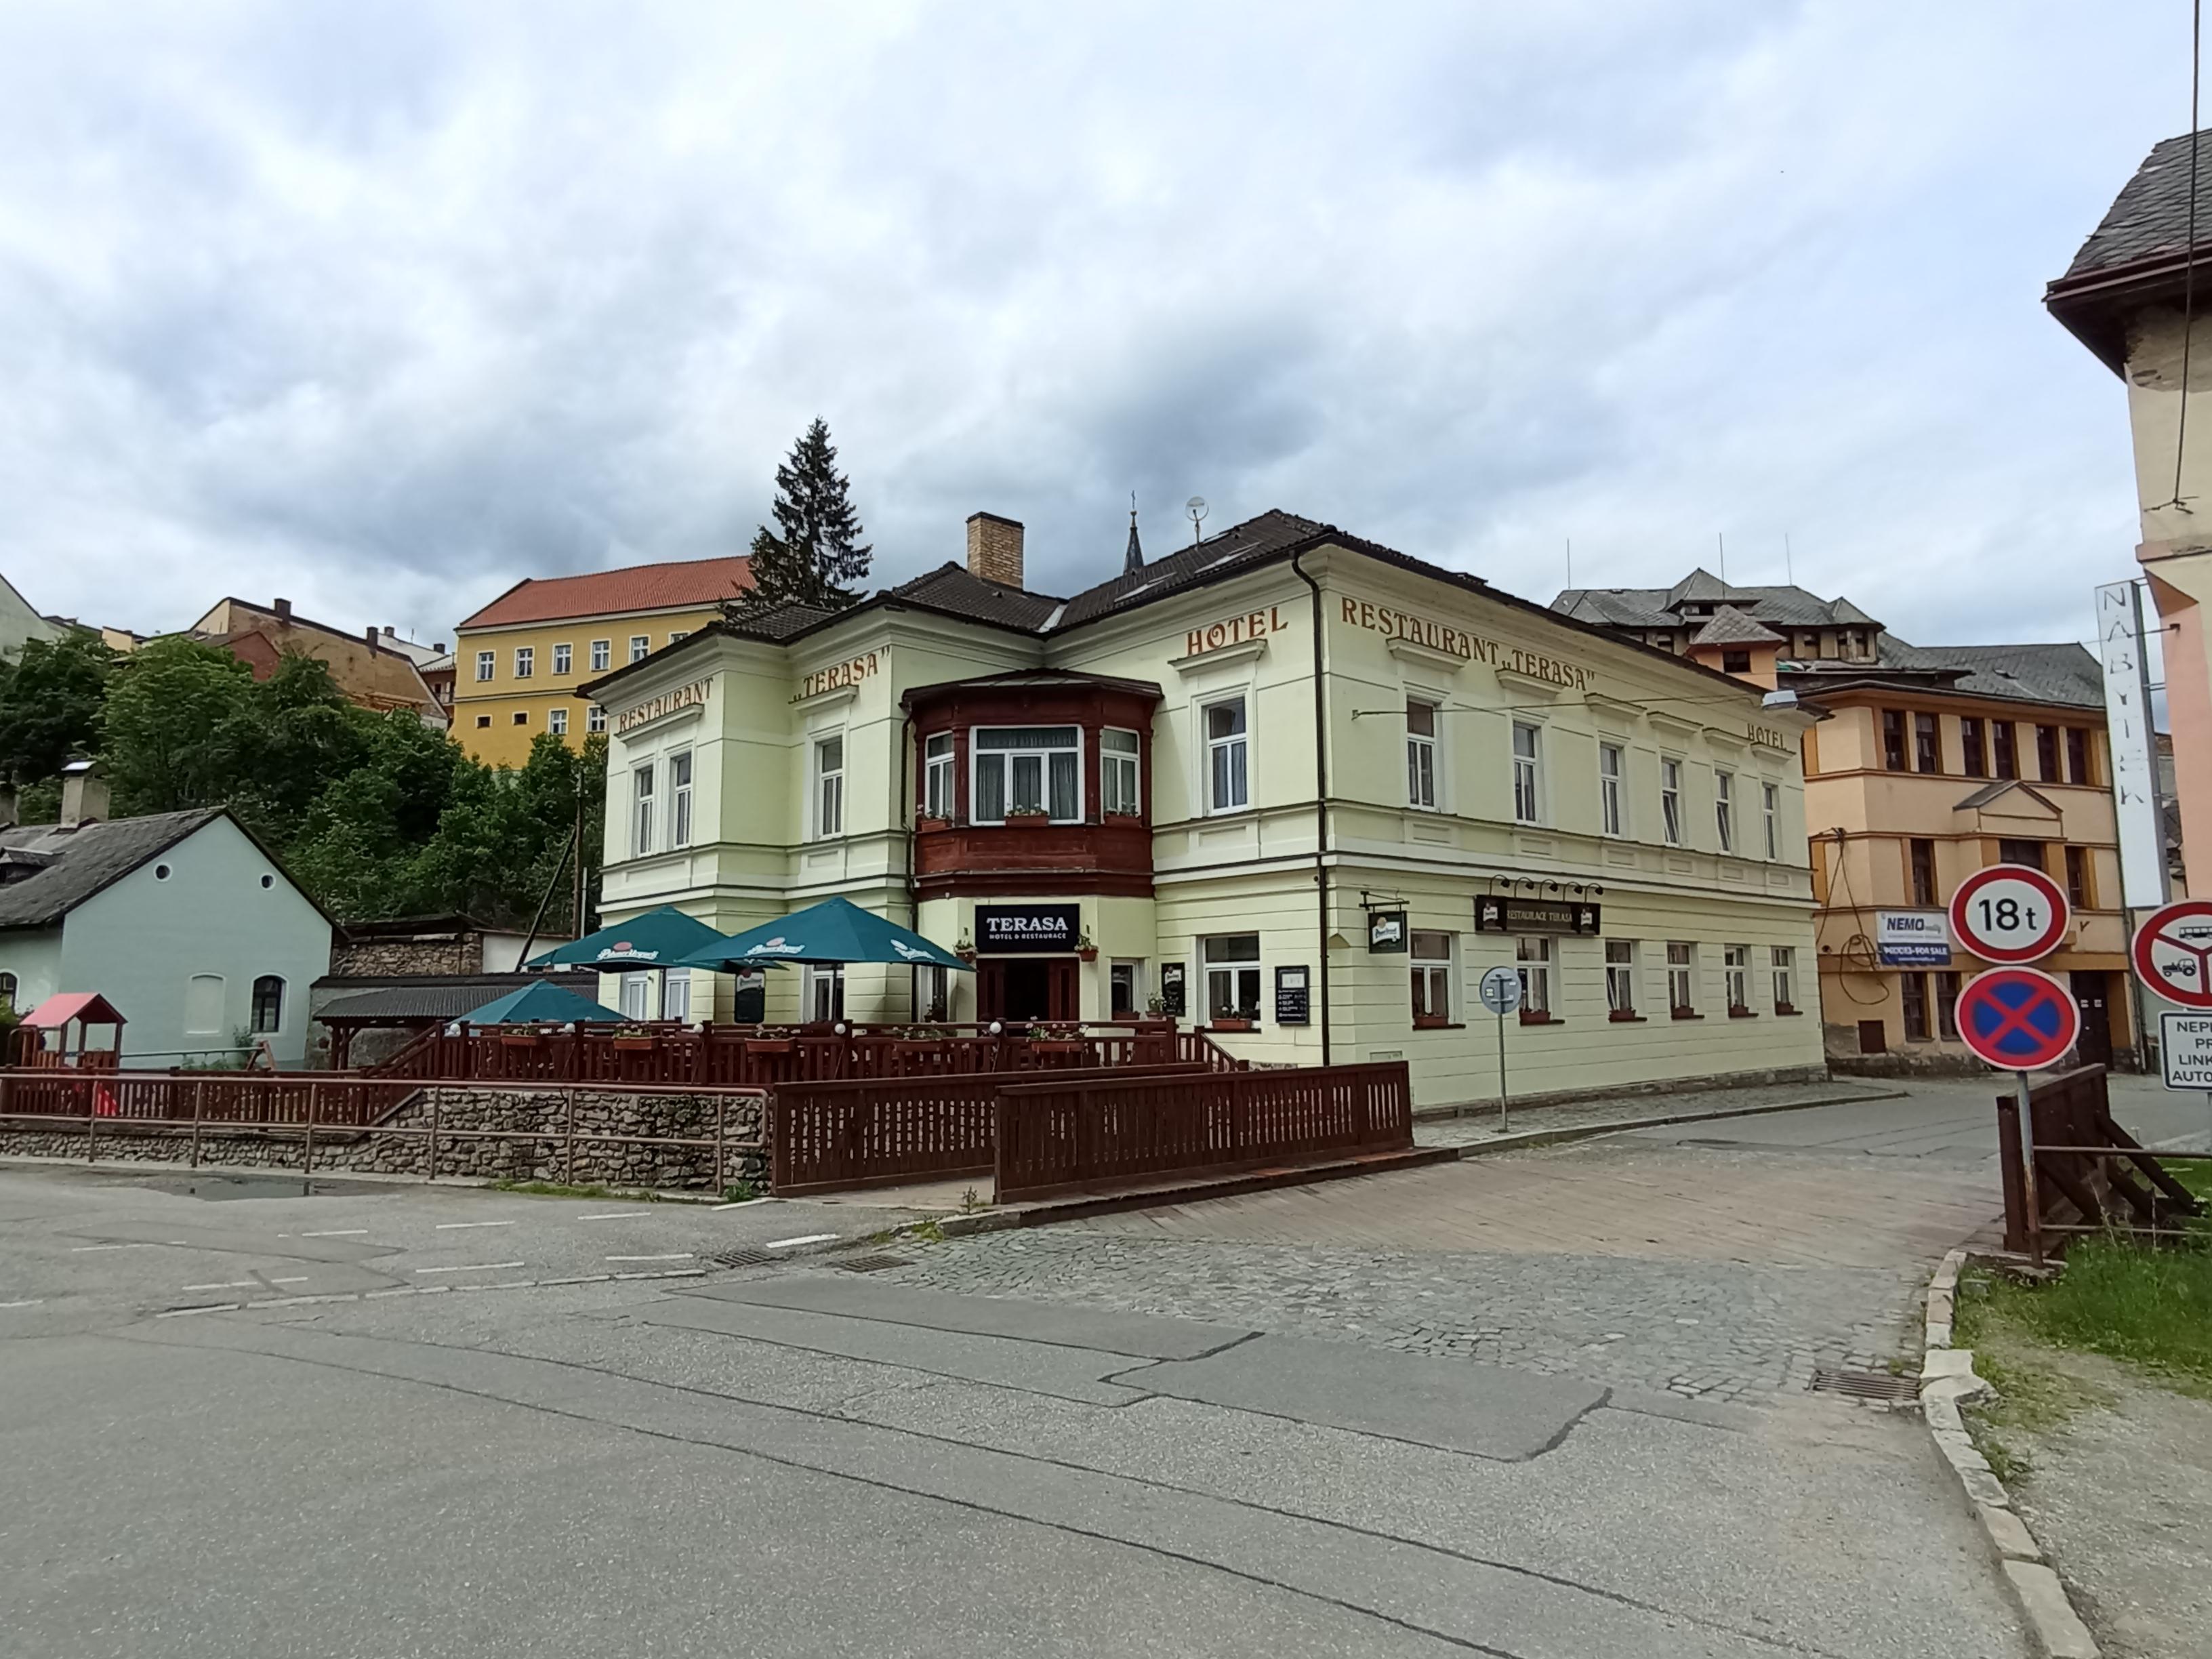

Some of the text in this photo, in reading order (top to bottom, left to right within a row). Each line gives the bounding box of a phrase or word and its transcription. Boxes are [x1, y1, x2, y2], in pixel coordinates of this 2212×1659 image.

[1187, 607, 1289, 657] HOTEL
[1341, 596, 1499, 665] RESTAURANT
[618, 678, 714, 733] RESTAURANT
[1747, 723, 1787, 750] HOTEL
[986, 917, 1069, 932] TERASA
[1887, 918, 1925, 931] NEMO
[1978, 898, 2037, 931] 18 t
[2176, 1021, 2212, 1033] NEP
